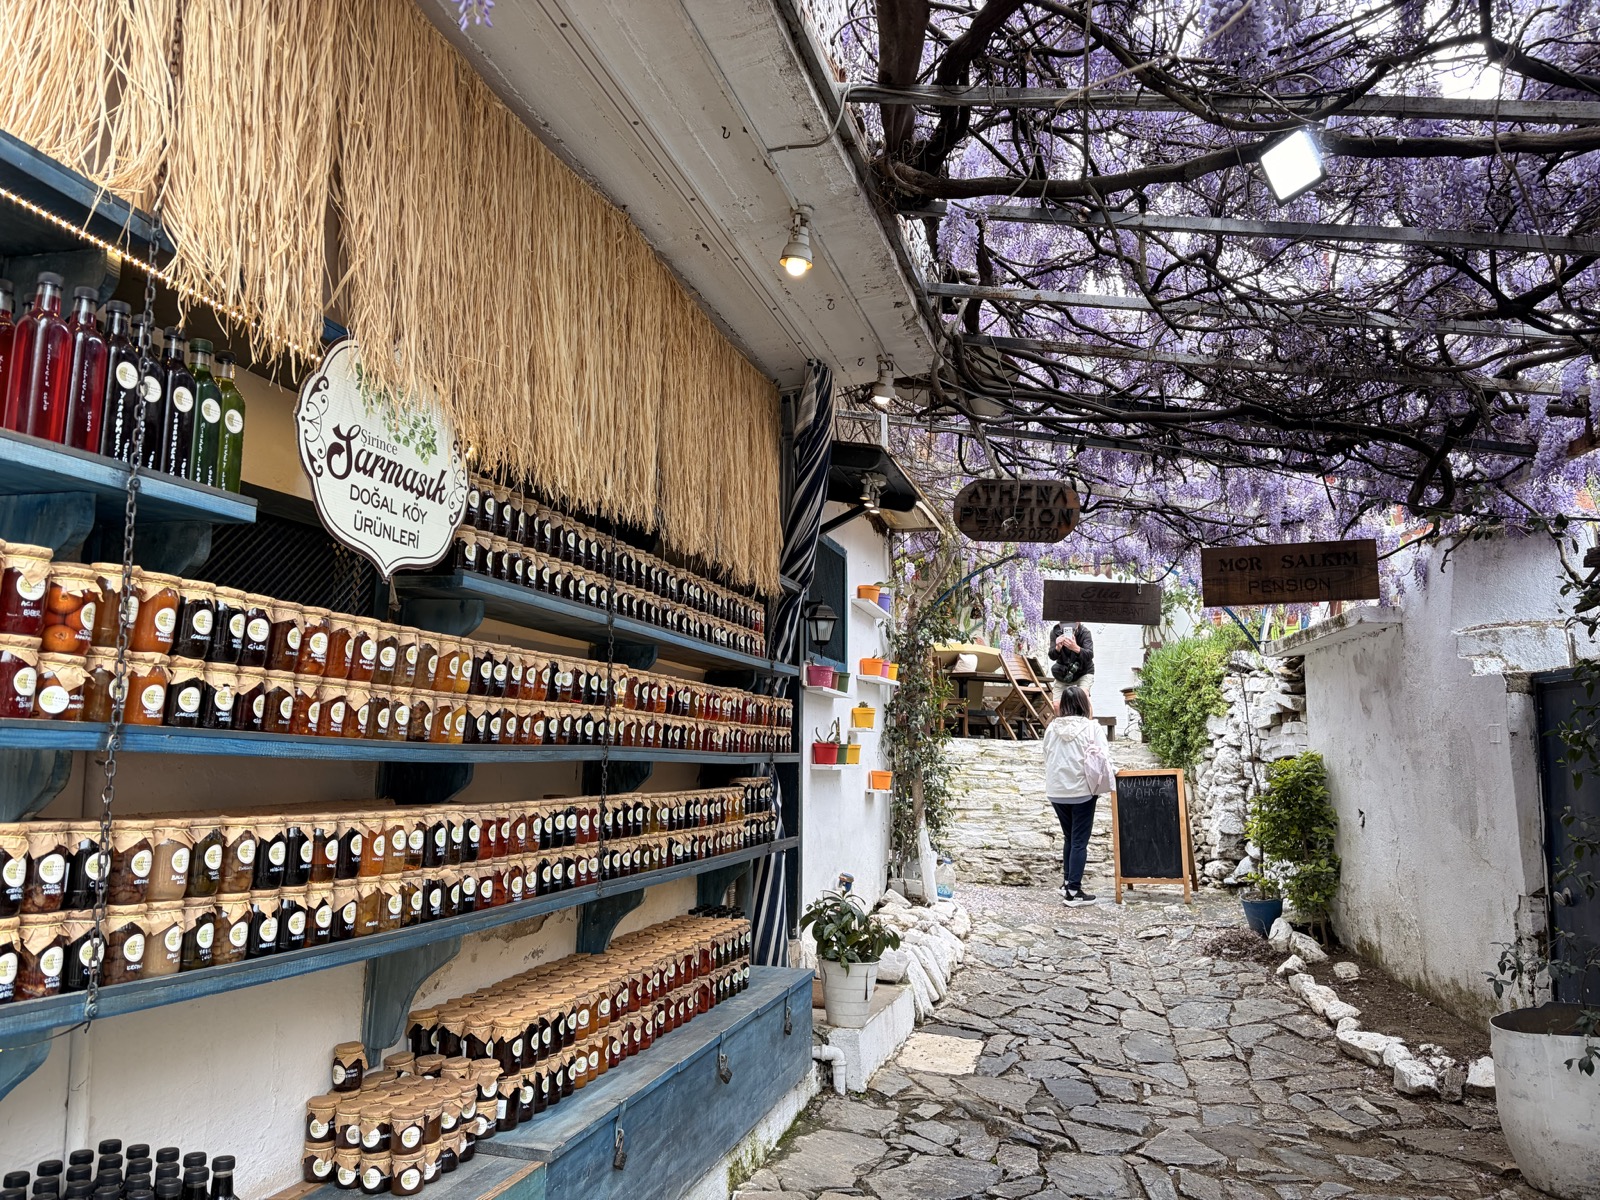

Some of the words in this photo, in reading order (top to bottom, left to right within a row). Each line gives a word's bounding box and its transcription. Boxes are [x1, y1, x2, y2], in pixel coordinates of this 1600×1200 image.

[360, 427, 399, 455] Şirince
[326, 423, 450, 506] Sarmaşık
[349, 483, 398, 516] DOĞAL
[402, 502, 428, 525] KÖY
[967, 484, 1068, 505] ATHENA
[958, 506, 1074, 527] PENSION
[353, 509, 420, 550] ÜRÜNLERİ
[1218, 556, 1263, 572] MOR
[1281, 551, 1359, 569] SALKIM
[1248, 577, 1331, 595] PENSION
